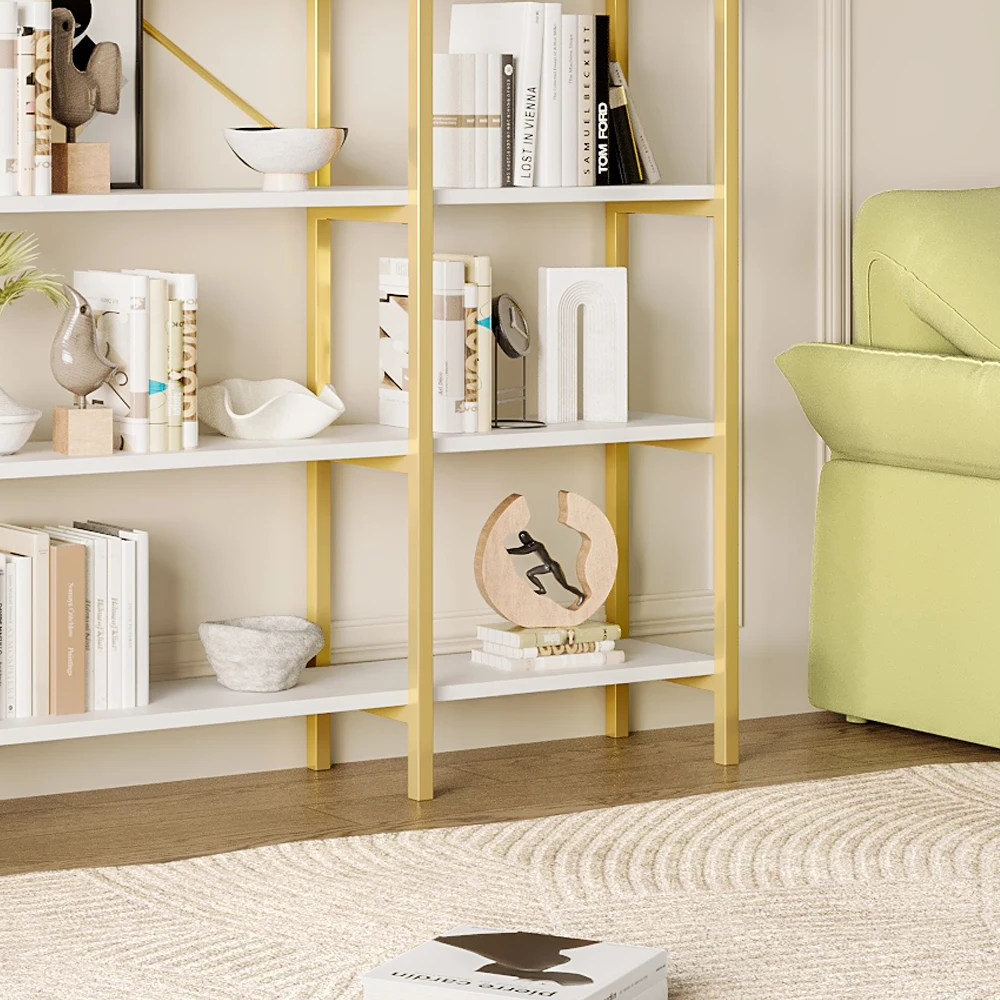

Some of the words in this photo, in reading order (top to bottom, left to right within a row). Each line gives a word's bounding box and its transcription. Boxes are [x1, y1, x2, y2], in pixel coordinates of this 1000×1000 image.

[583, 26, 591, 100] BECKETT
[523, 86, 537, 129] VIENNA
[598, 102, 608, 139] FORD
[523, 134, 534, 145] IN
[583, 107, 591, 175] SAMUEL
[520, 148, 533, 179] LOST
[598, 144, 608, 174] TOM
[391, 971, 472, 987] cardin
[478, 983, 558, 998] pierre
